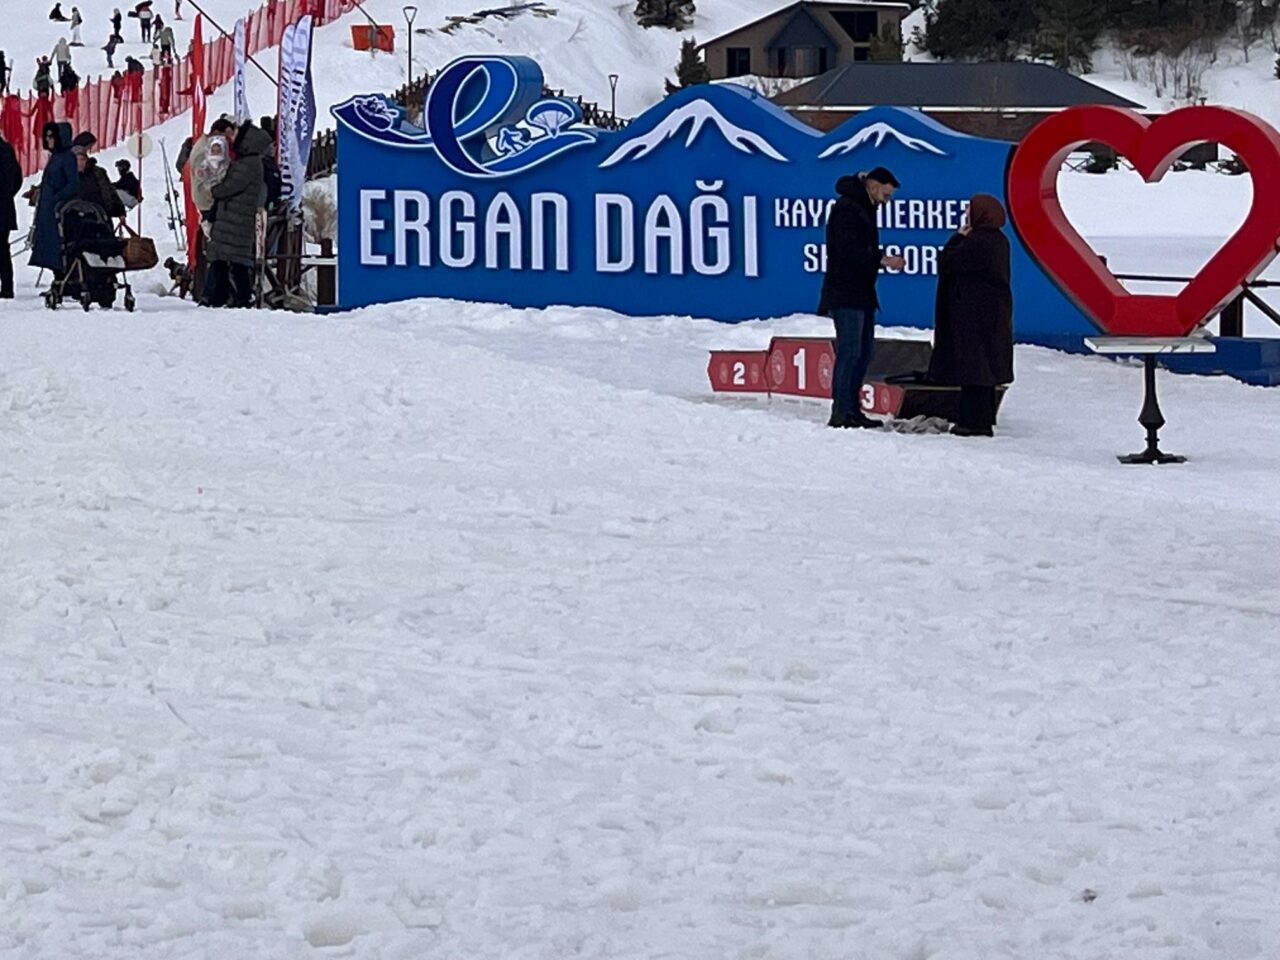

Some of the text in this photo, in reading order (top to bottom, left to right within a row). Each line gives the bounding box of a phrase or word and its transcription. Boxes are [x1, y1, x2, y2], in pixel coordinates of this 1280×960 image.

[360, 180, 758, 277] ERGAN DAĞI
[733, 361, 745, 385] 2
[793, 348, 806, 390] 1
[861, 384, 875, 409] 3
